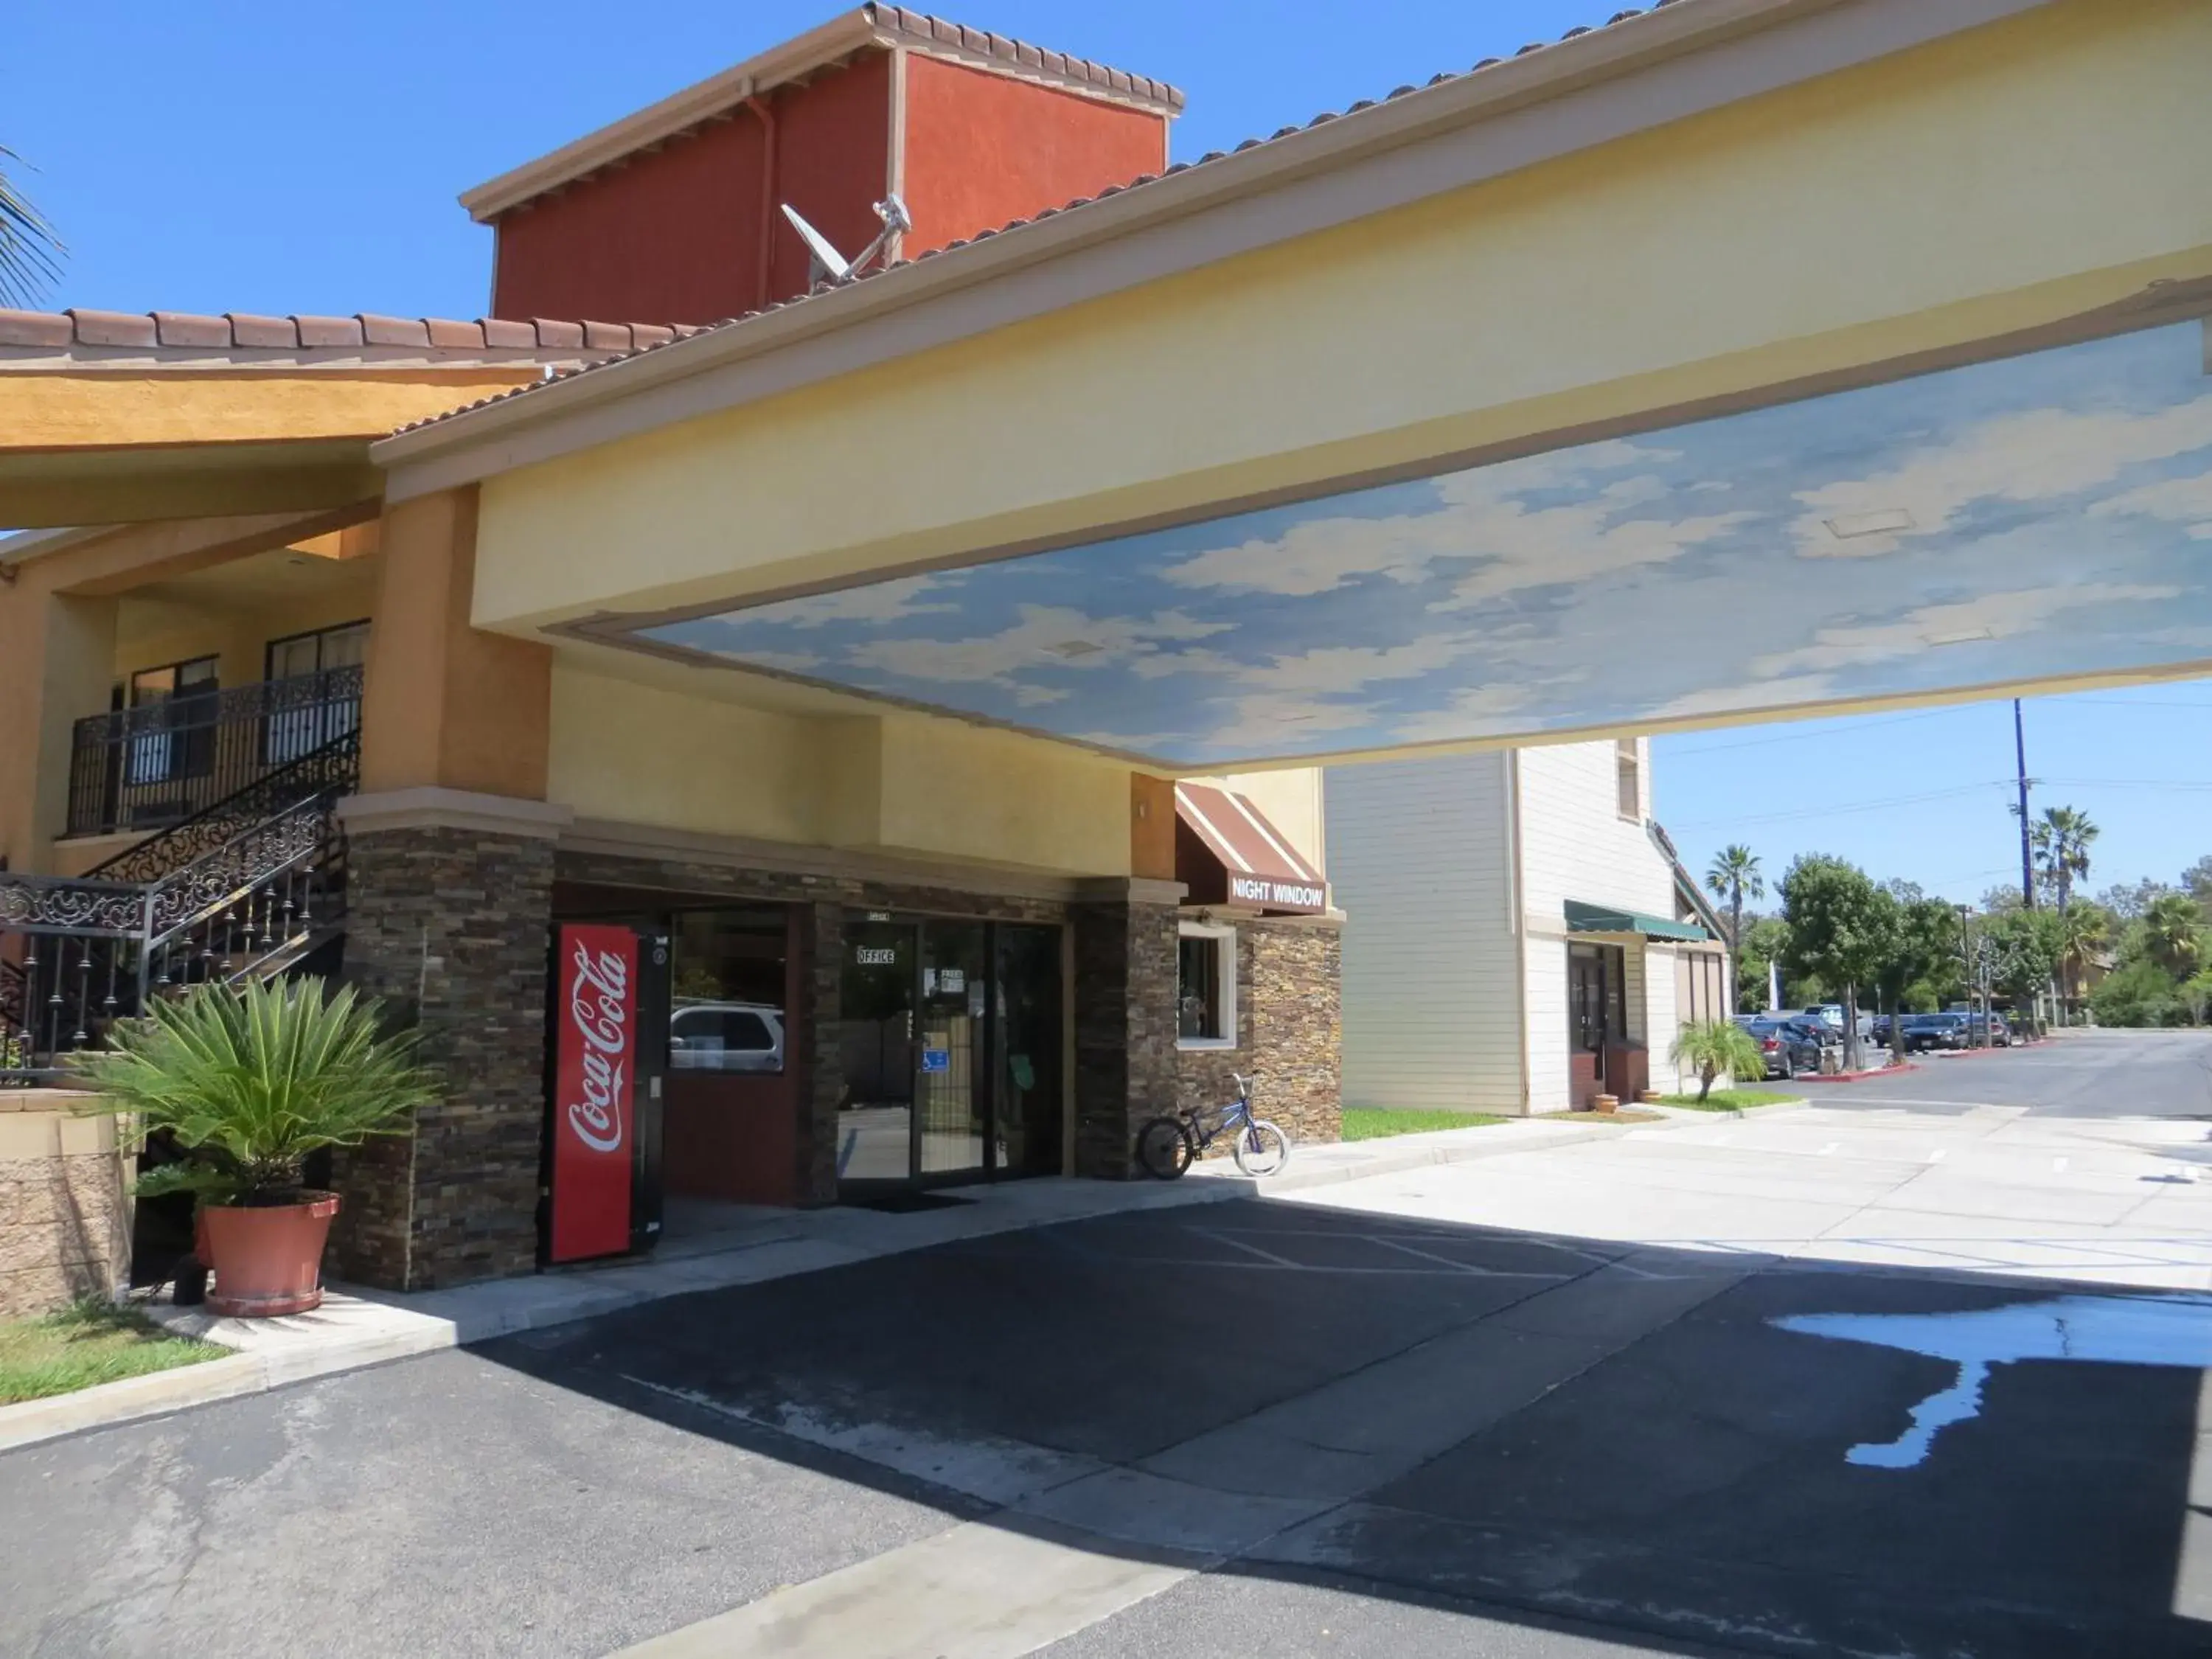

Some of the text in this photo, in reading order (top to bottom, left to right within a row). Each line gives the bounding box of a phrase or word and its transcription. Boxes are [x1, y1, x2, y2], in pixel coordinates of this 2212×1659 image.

[1232, 877, 1323, 907] NIGHT WINDOW
[859, 950, 894, 963] OFFICE
